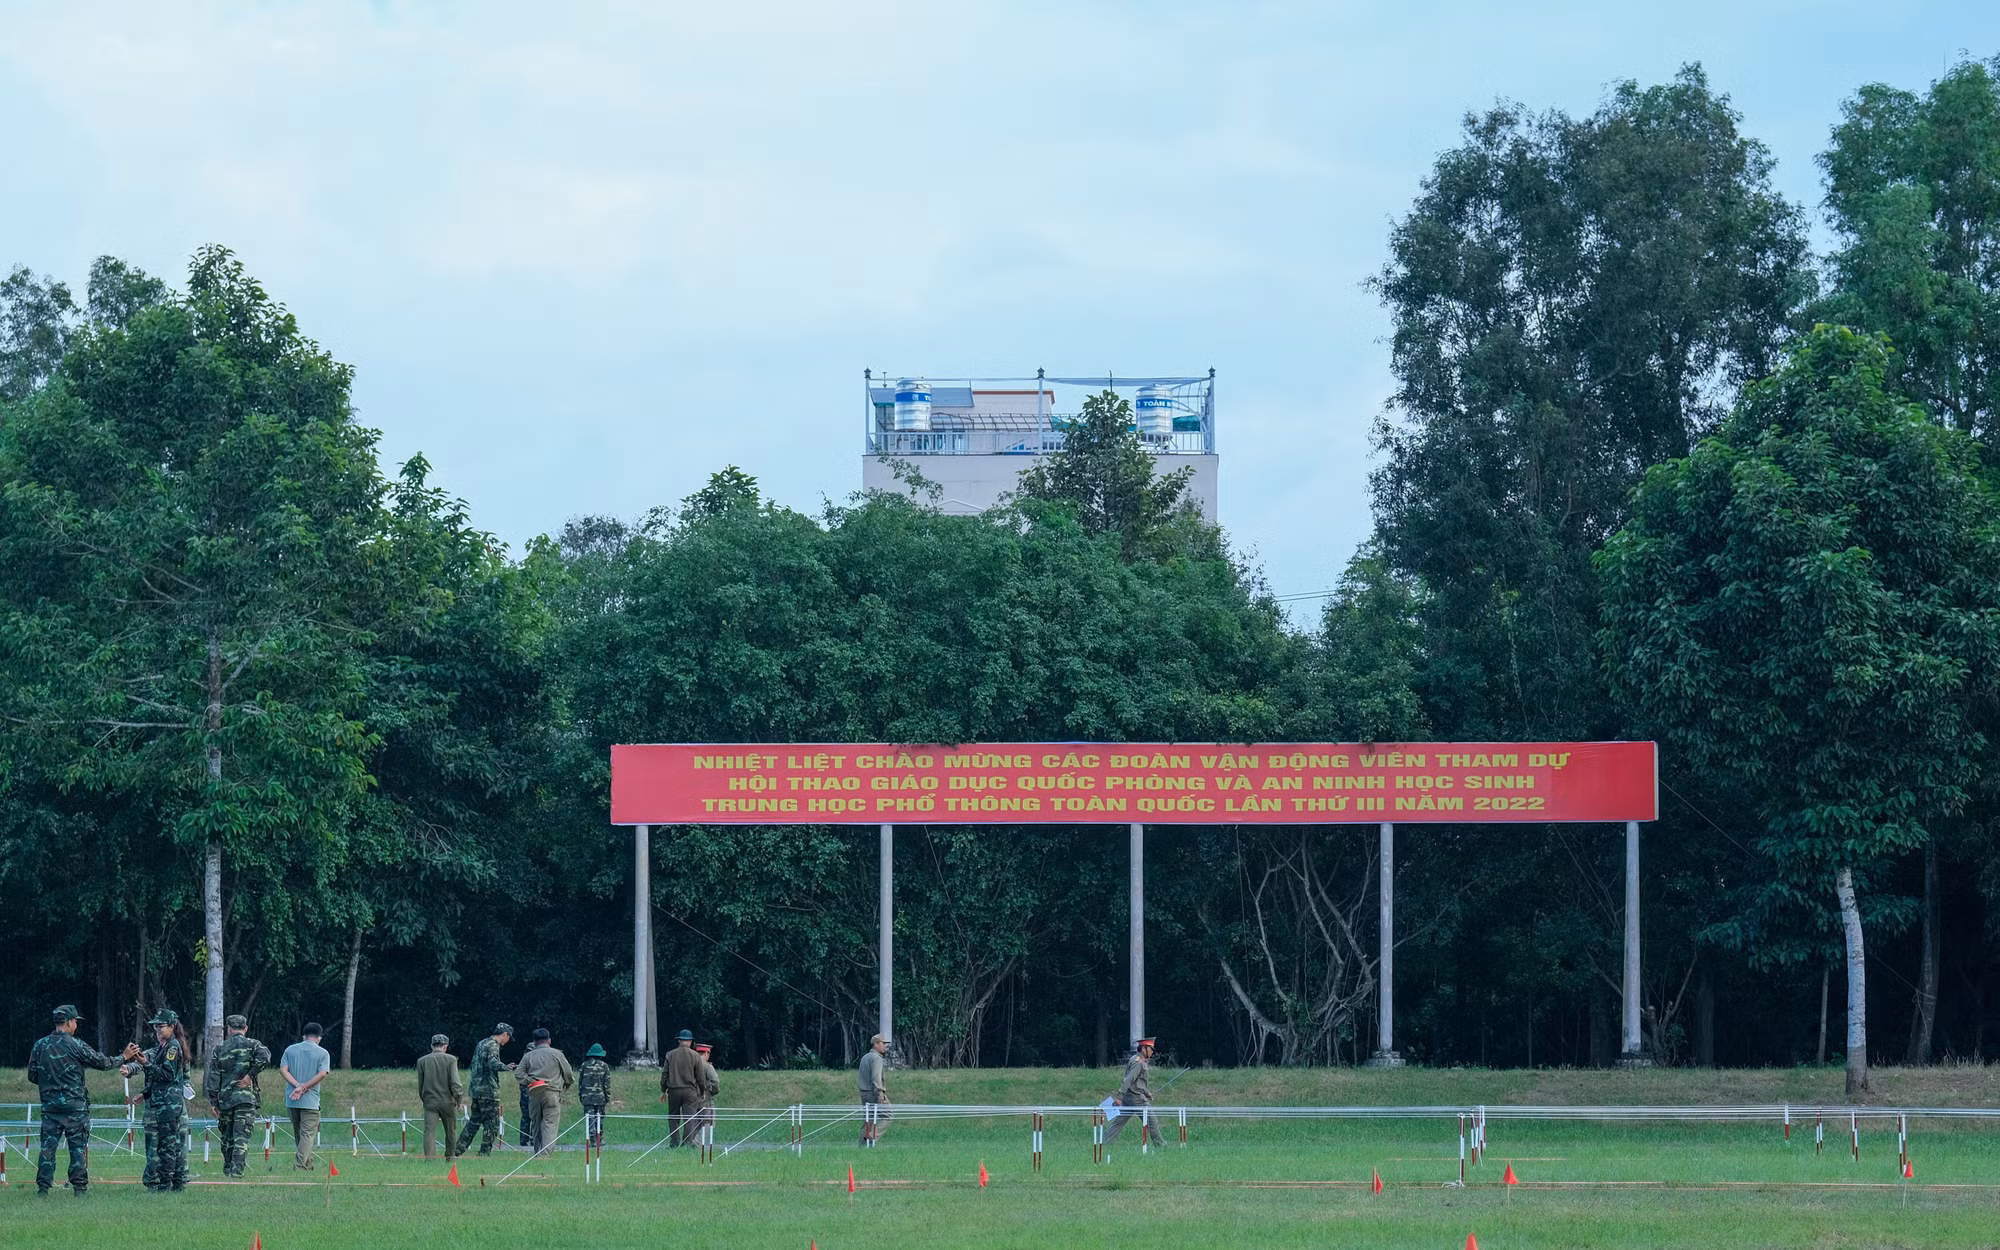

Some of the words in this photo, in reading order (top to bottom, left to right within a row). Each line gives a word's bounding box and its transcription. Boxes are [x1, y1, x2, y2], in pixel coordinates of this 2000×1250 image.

[693, 753, 778, 771] NHIỆT
[788, 753, 845, 771] LIỆT
[856, 752, 934, 768] CHÀO
[944, 752, 1032, 768] MỪNG
[1042, 752, 1099, 768] CÁC
[1107, 752, 1190, 768] ĐOÀN
[1200, 752, 1258, 771] VẬN
[1268, 752, 1348, 771] ĐỘNG
[1359, 752, 1426, 768] VIÊN
[1436, 753, 1518, 767] THAM
[1528, 752, 1570, 770] DỰ
[729, 774, 777, 793] HỘI
[786, 777, 860, 790] THAO
[871, 774, 938, 789] GIÁO
[949, 776, 1007, 792] DỤC
[1017, 772, 1095, 791] QUỐC
[1105, 773, 1205, 790] PHÒNG
[1215, 774, 1253, 790] VÀ
[1262, 776, 1303, 790] AN
[1313, 776, 1385, 789] NINH
[1396, 776, 1454, 792] HỌC
[1464, 776, 1534, 789] SINH
[702, 798, 798, 812] TRUNG
[808, 798, 866, 814] HỌC
[876, 793, 936, 811] PHỔ
[944, 795, 1041, 811] THÔNG
[1050, 795, 1127, 811] TOÀN
[1137, 794, 1215, 812] QUỐC
[1226, 794, 1281, 811] LẦN
[1291, 795, 1350, 811] THỨ
[1356, 797, 1384, 811] III
[1396, 795, 1464, 811] NĂM
[1474, 797, 1544, 811] 2022
